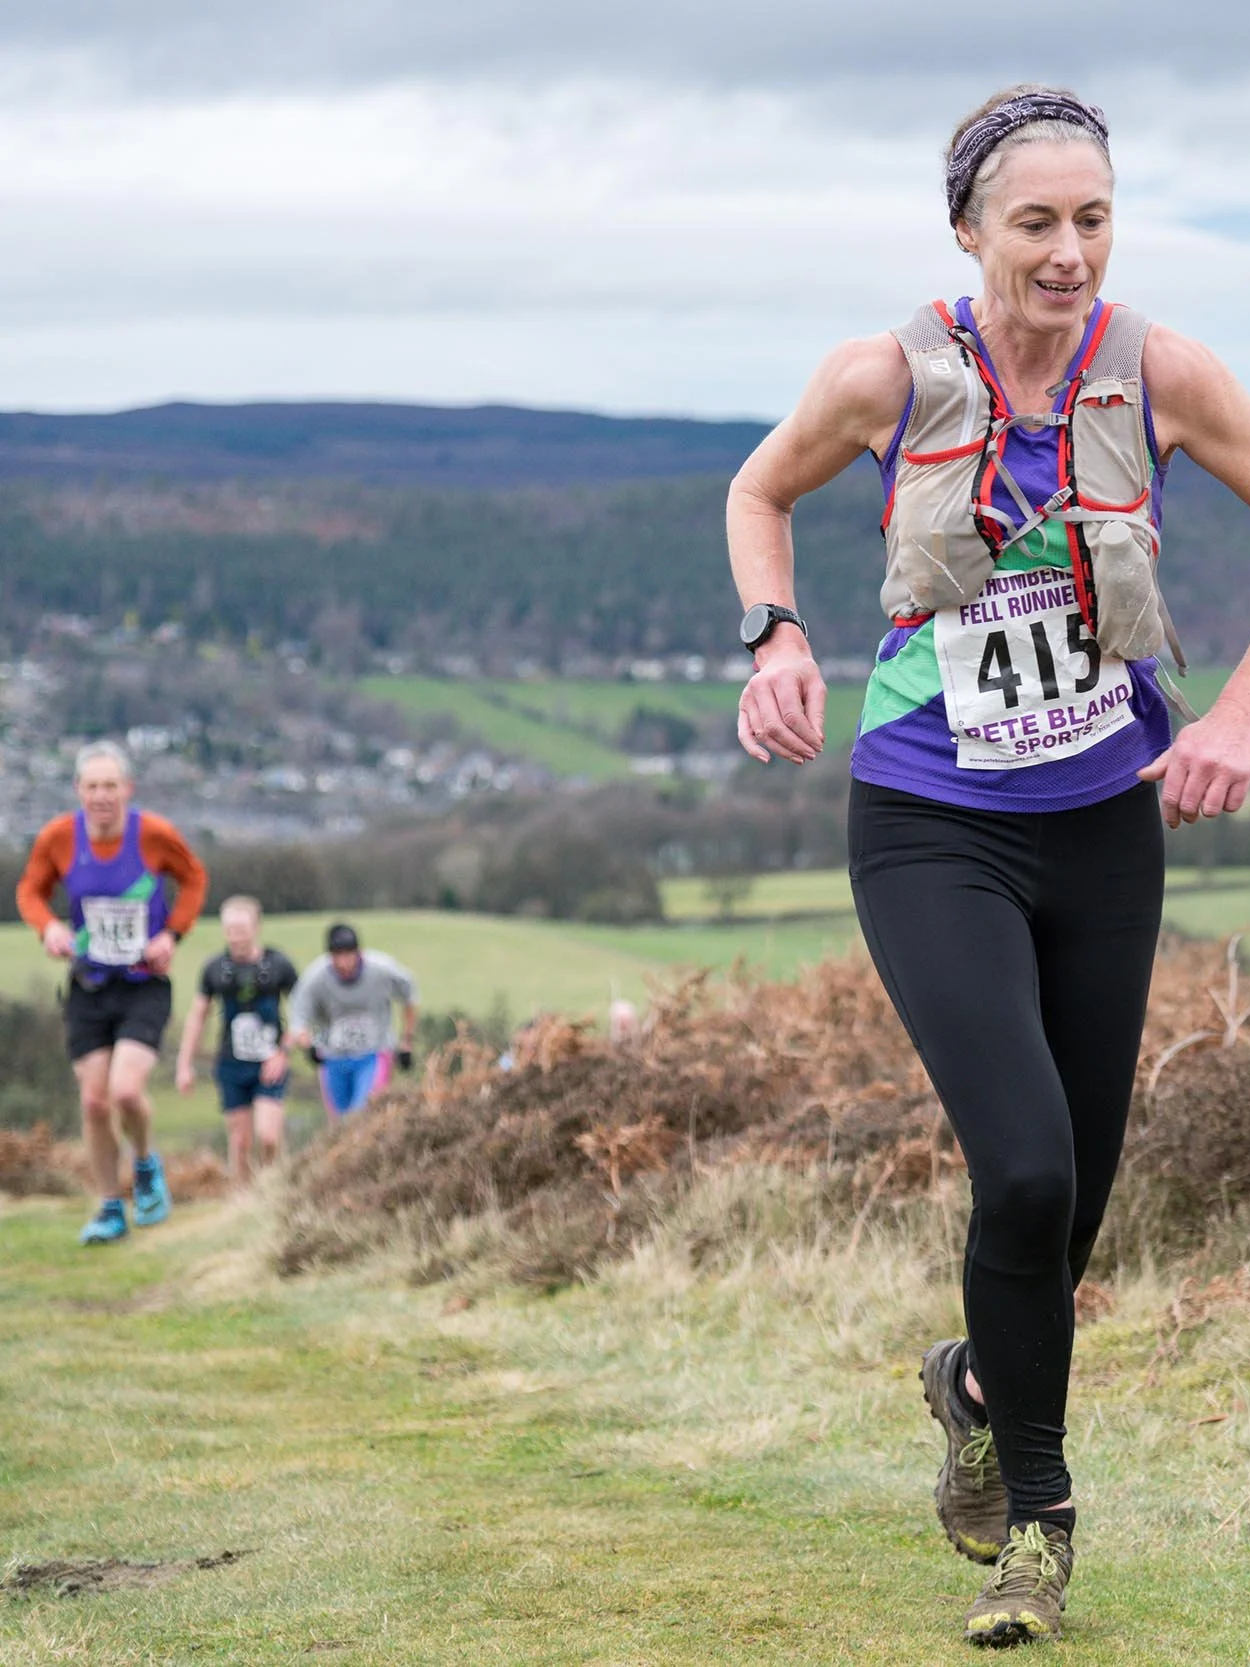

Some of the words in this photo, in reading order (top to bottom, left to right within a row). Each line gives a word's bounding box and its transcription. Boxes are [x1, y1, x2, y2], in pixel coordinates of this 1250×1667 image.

[960, 601, 1003, 625] FELL
[977, 612, 1101, 709] 415
[964, 714, 1040, 745] PETE
[1047, 683, 1130, 730] BLAND
[1015, 722, 1094, 756] SPORTS
